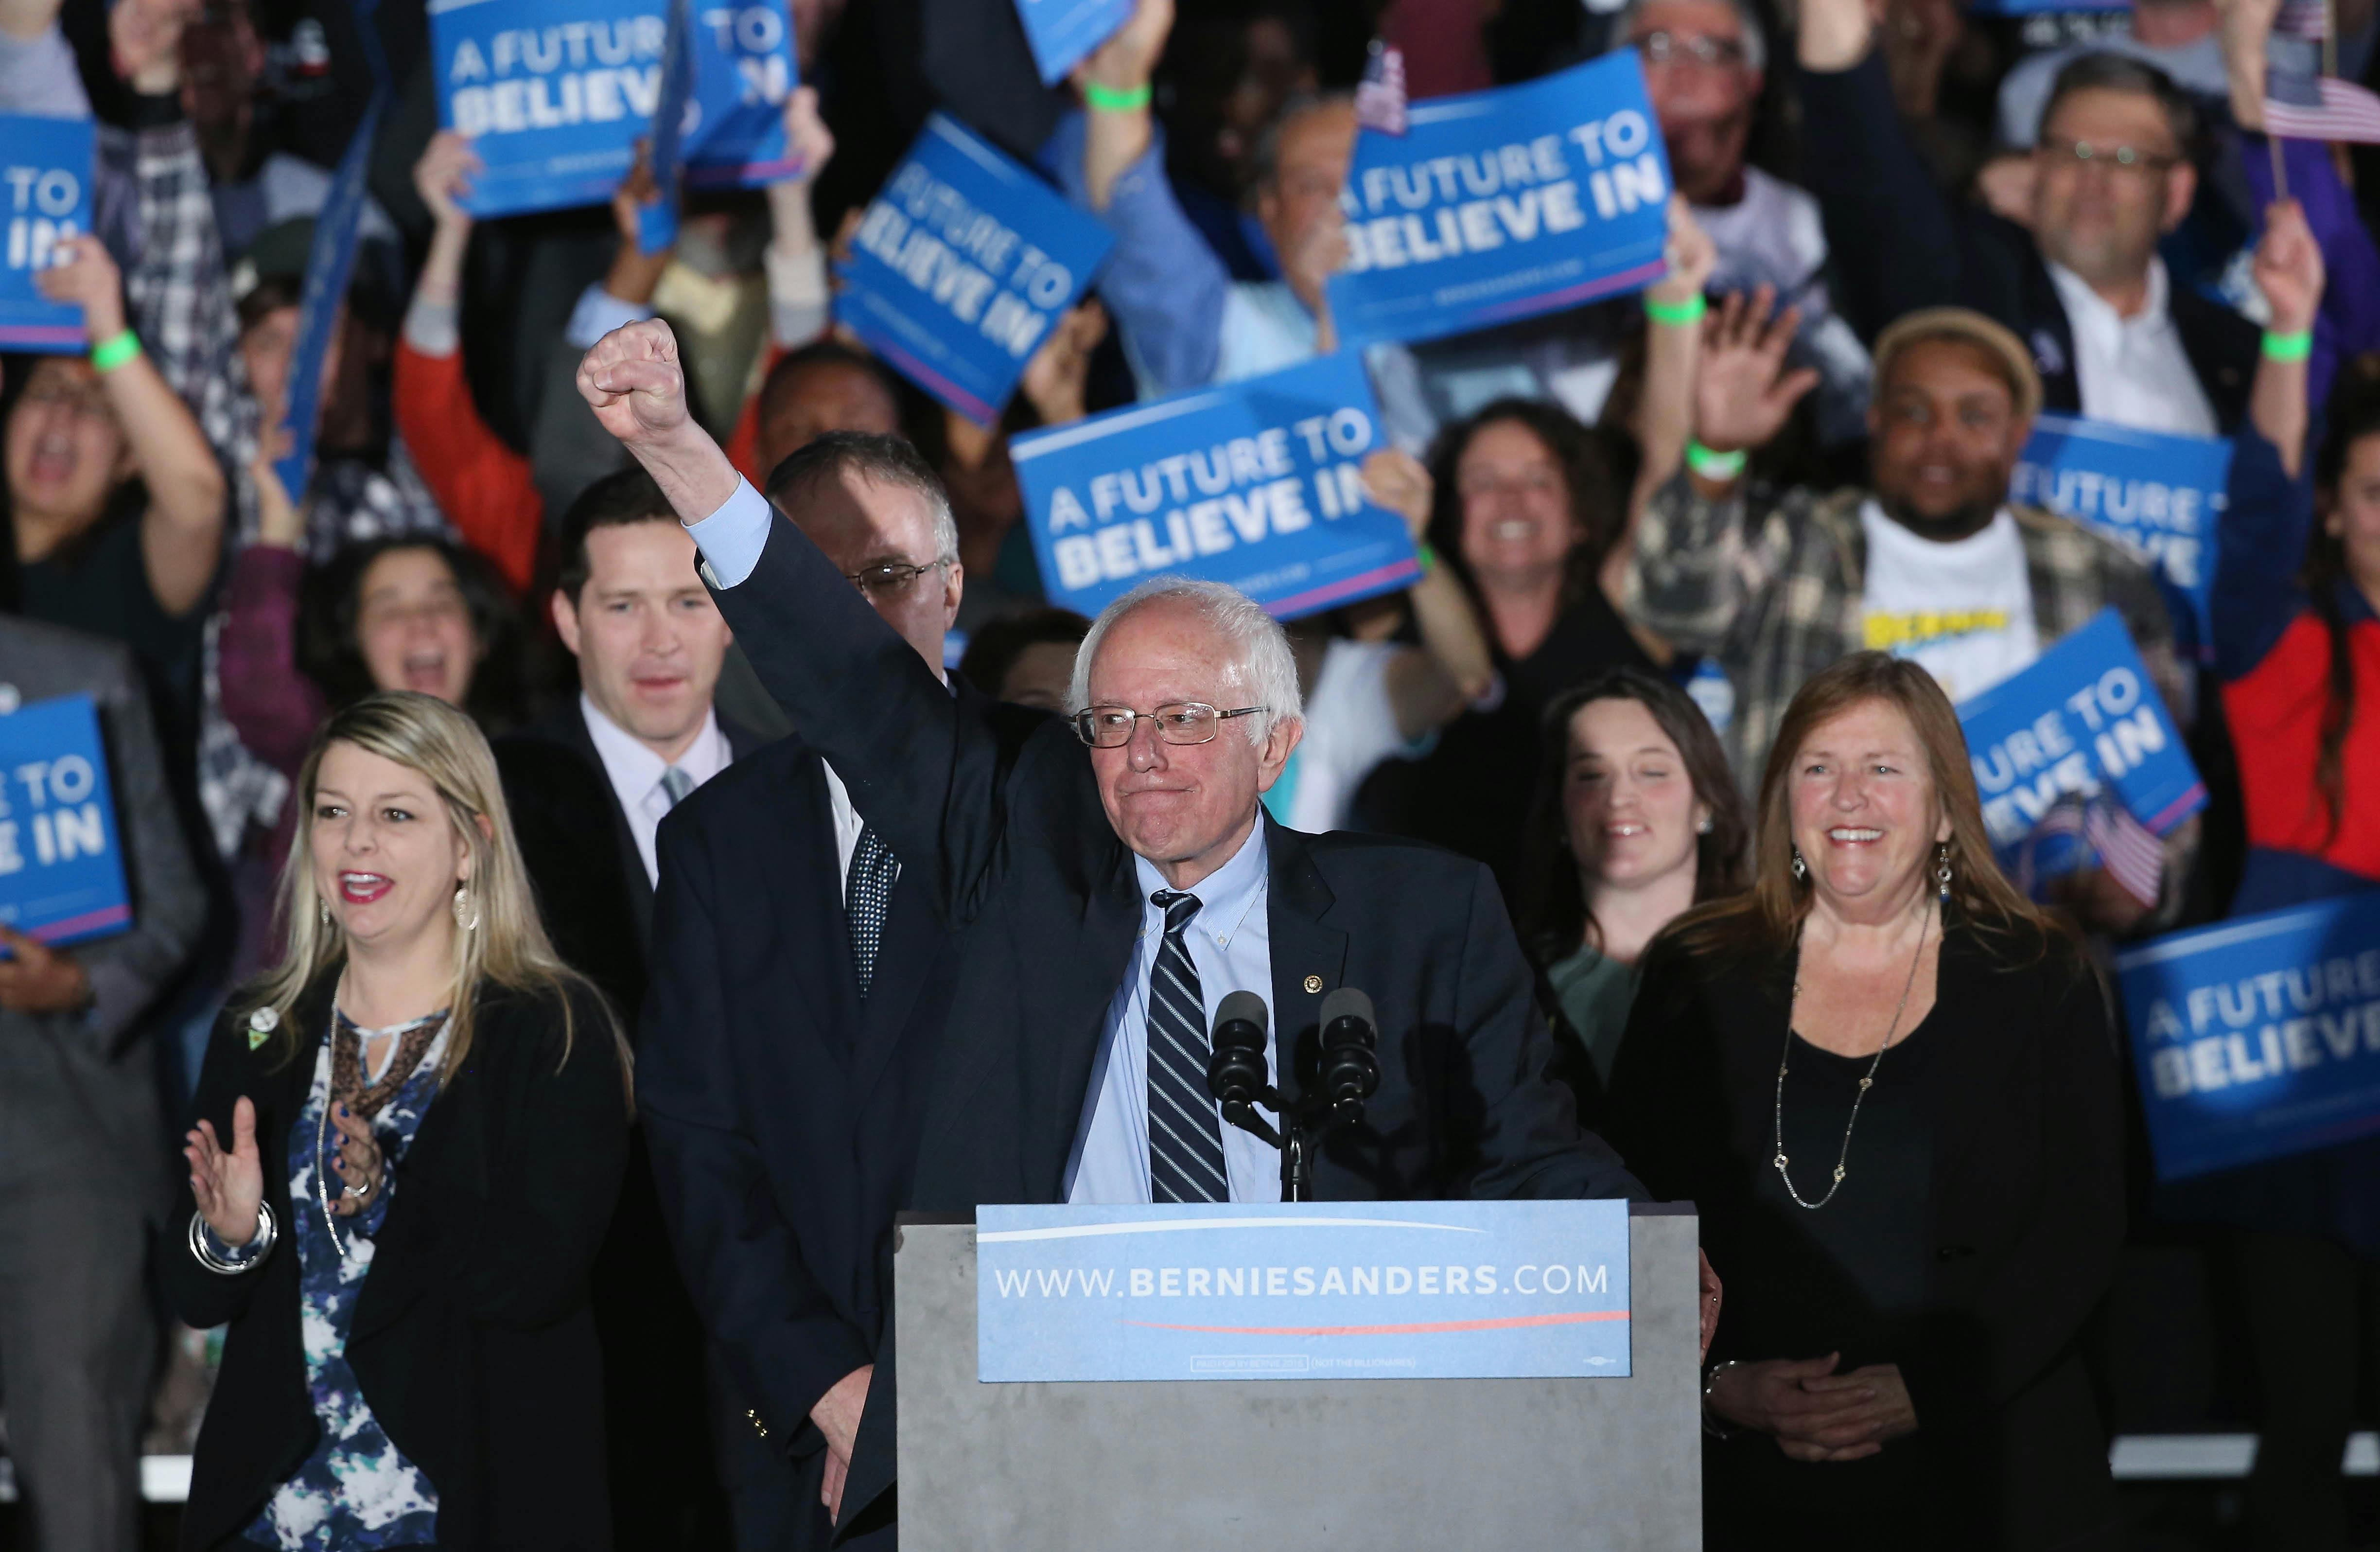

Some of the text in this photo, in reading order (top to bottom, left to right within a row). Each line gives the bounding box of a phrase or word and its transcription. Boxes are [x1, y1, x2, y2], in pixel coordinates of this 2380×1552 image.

[451, 5, 783, 86] A FUTUR TO
[452, 65, 664, 139] BELIEV
[4, 166, 80, 217] TO
[1363, 134, 1570, 214] FUTURE
[1567, 110, 1648, 166] TO
[1590, 152, 1666, 220] IN
[858, 198, 997, 324] ELIEVE
[980, 291, 1047, 359] IN
[1011, 244, 1072, 310] TO
[1048, 407, 1372, 534] A FUTURE TO
[2009, 461, 2203, 534] FUTURE
[1053, 477, 1312, 590] BELIEVE
[1970, 666, 2139, 794] URE TO
[2094, 704, 2166, 778] IN
[15, 754, 94, 809] TO
[33, 801, 105, 866] IN
[2146, 948, 2380, 1043] A FUTURE
[995, 1264, 1607, 1298] WWW.BERNIESANDERS.COM
